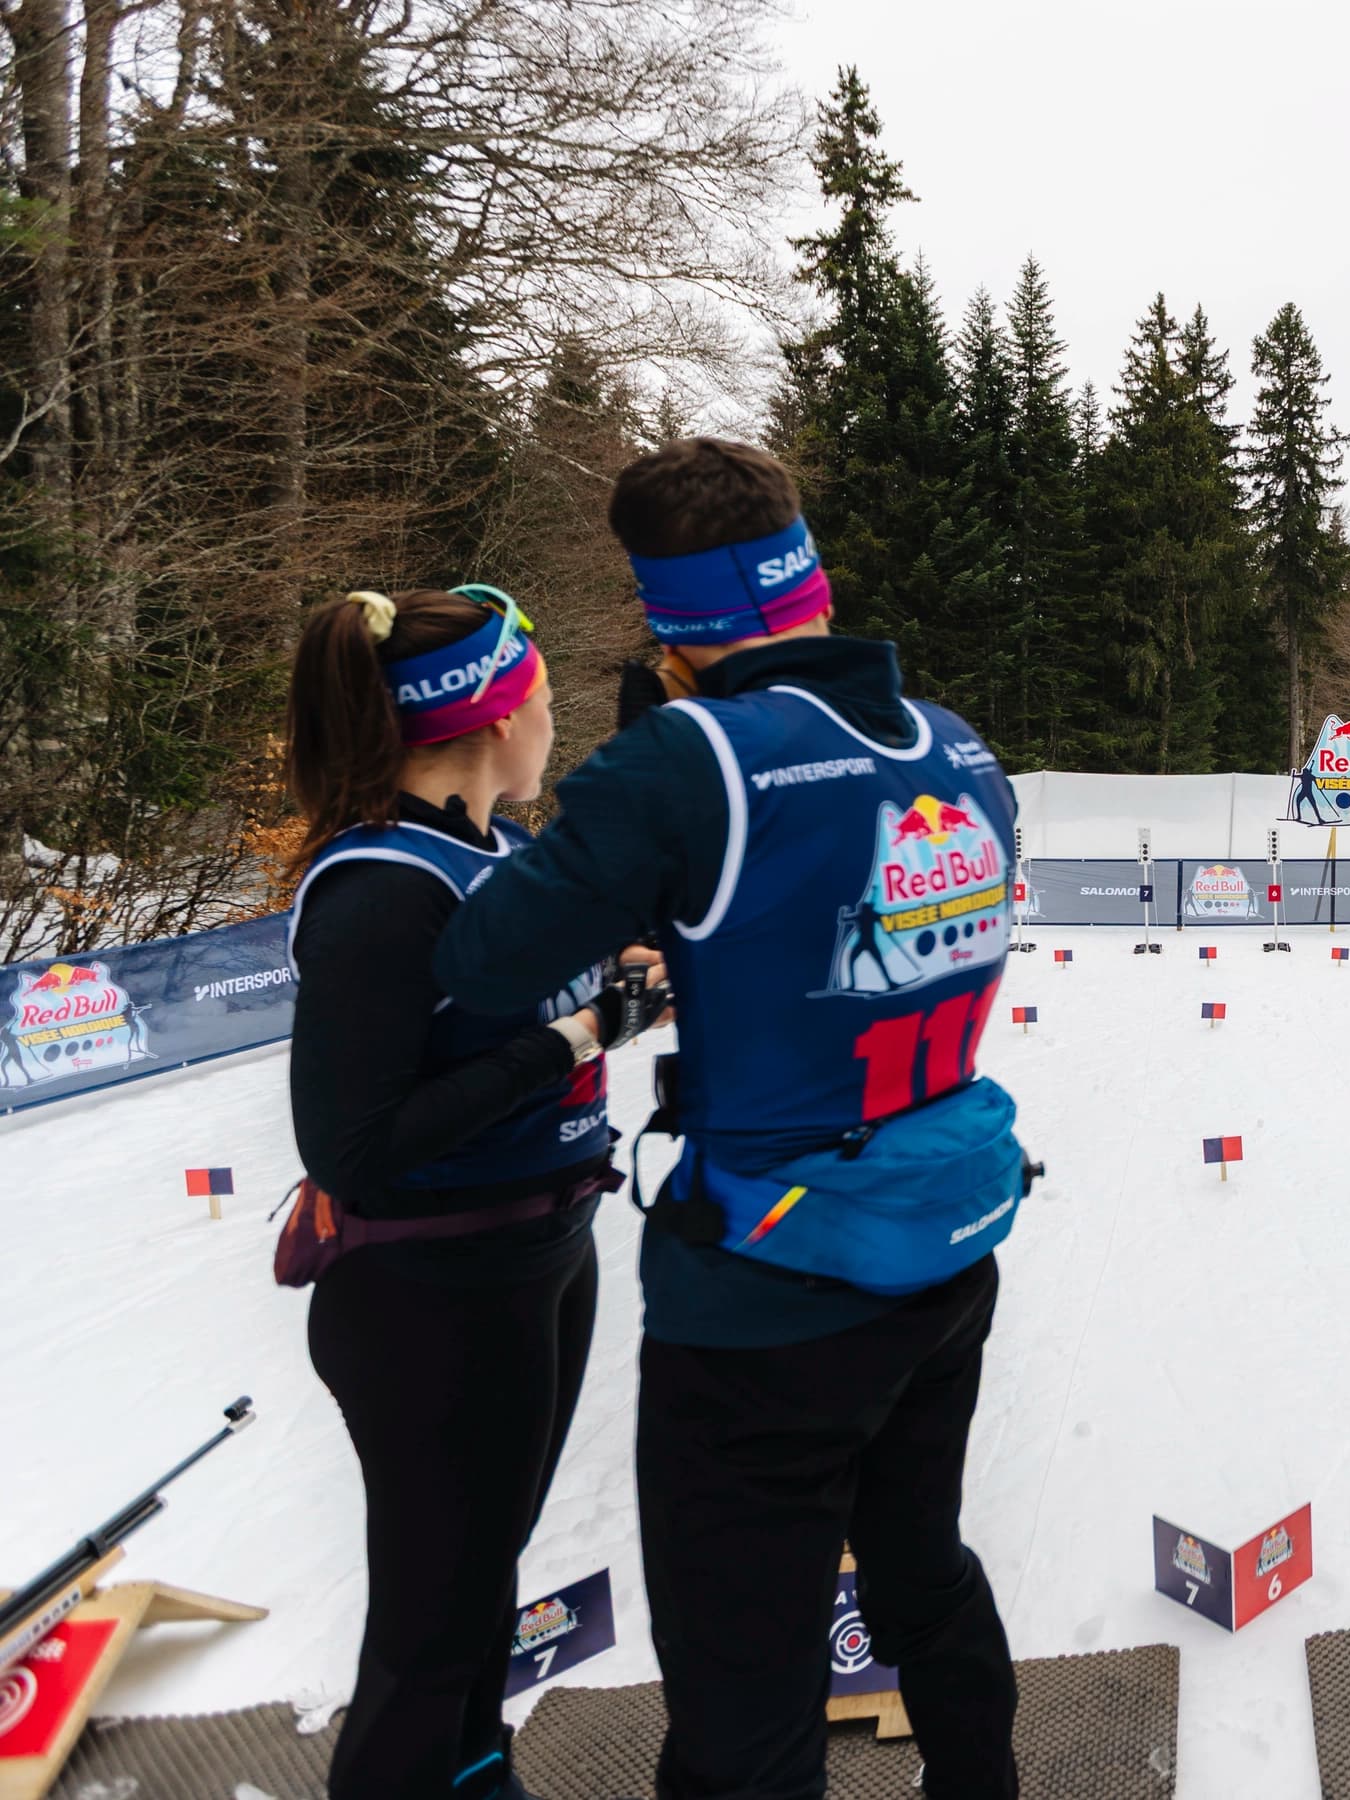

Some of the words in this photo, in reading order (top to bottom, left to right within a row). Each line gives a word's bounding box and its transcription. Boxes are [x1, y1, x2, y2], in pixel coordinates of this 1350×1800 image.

[772, 757, 877, 787] INTERSPORT
[884, 852, 948, 903] Red
[947, 839, 1000, 887] Bull
[1195, 880, 1219, 892] Red
[1220, 880, 1244, 892] Bull
[20, 996, 72, 1029] Red
[72, 988, 118, 1019] Bull
[1184, 1579, 1200, 1606] 7
[1267, 1572, 1283, 1601] 6
[520, 1619, 543, 1633] Red
[542, 1607, 563, 1622] Bull
[533, 1644, 559, 1680] 7
